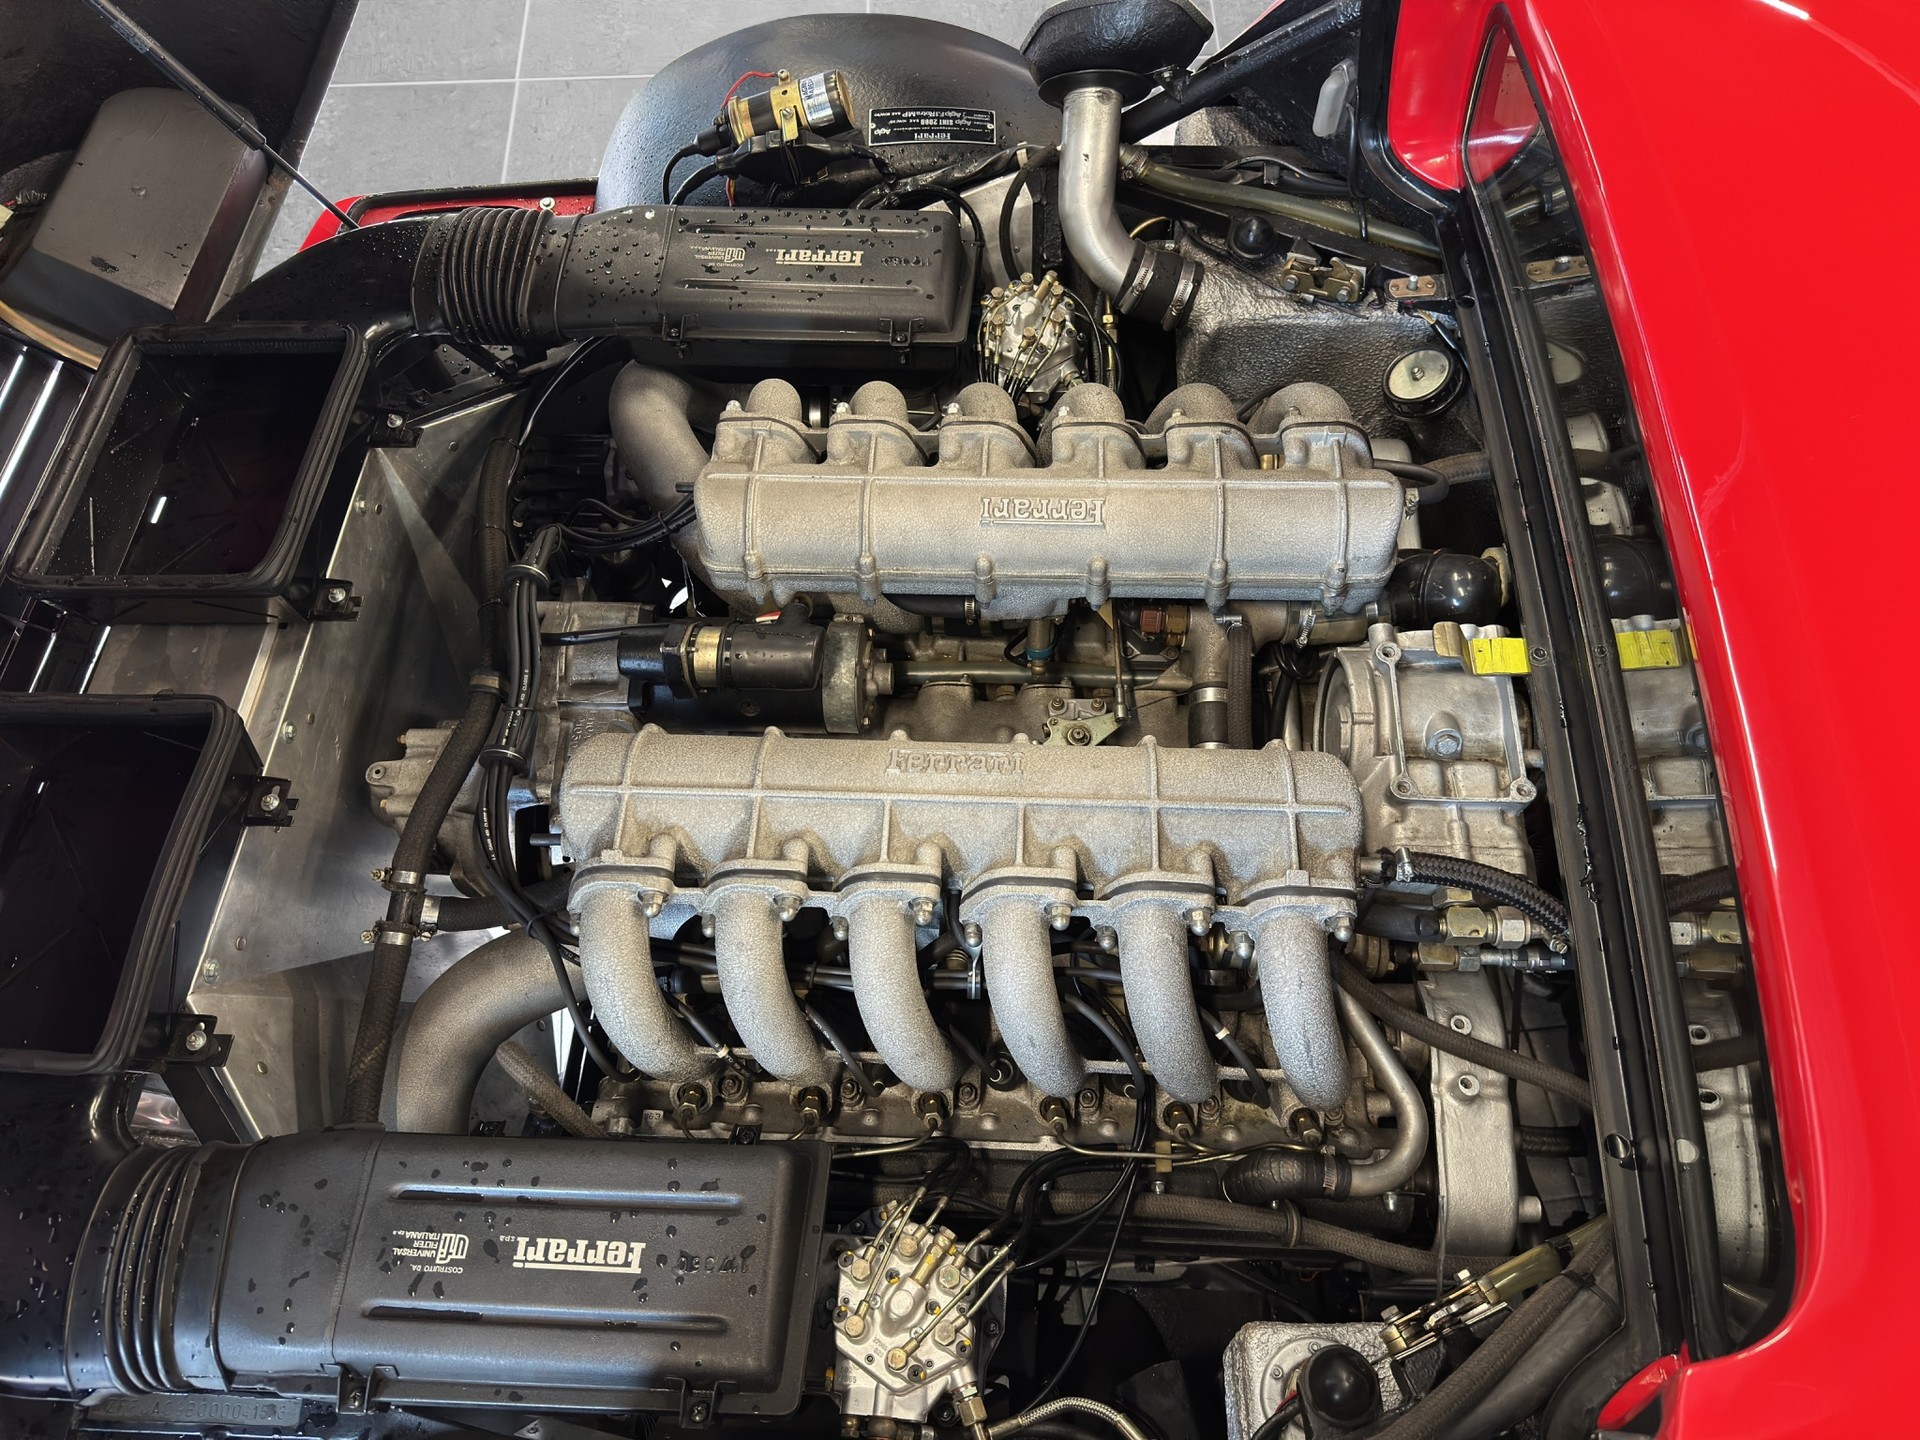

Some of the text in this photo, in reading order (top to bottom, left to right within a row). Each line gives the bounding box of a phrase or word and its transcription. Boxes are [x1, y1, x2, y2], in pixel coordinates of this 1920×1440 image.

[874, 128, 891, 136] Agip
[914, 132, 951, 140] Ferrari
[775, 249, 864, 266] Ferrari
[981, 498, 1105, 526] Ferrari
[885, 749, 1025, 778] Ferrari
[406, 1231, 440, 1240] ITALIANA
[413, 1240, 438, 1249] FILTER
[393, 1248, 436, 1257] UNIVERSAL
[512, 1236, 646, 1274] Ferrari
[424, 1265, 463, 1274] COSTRUITO
